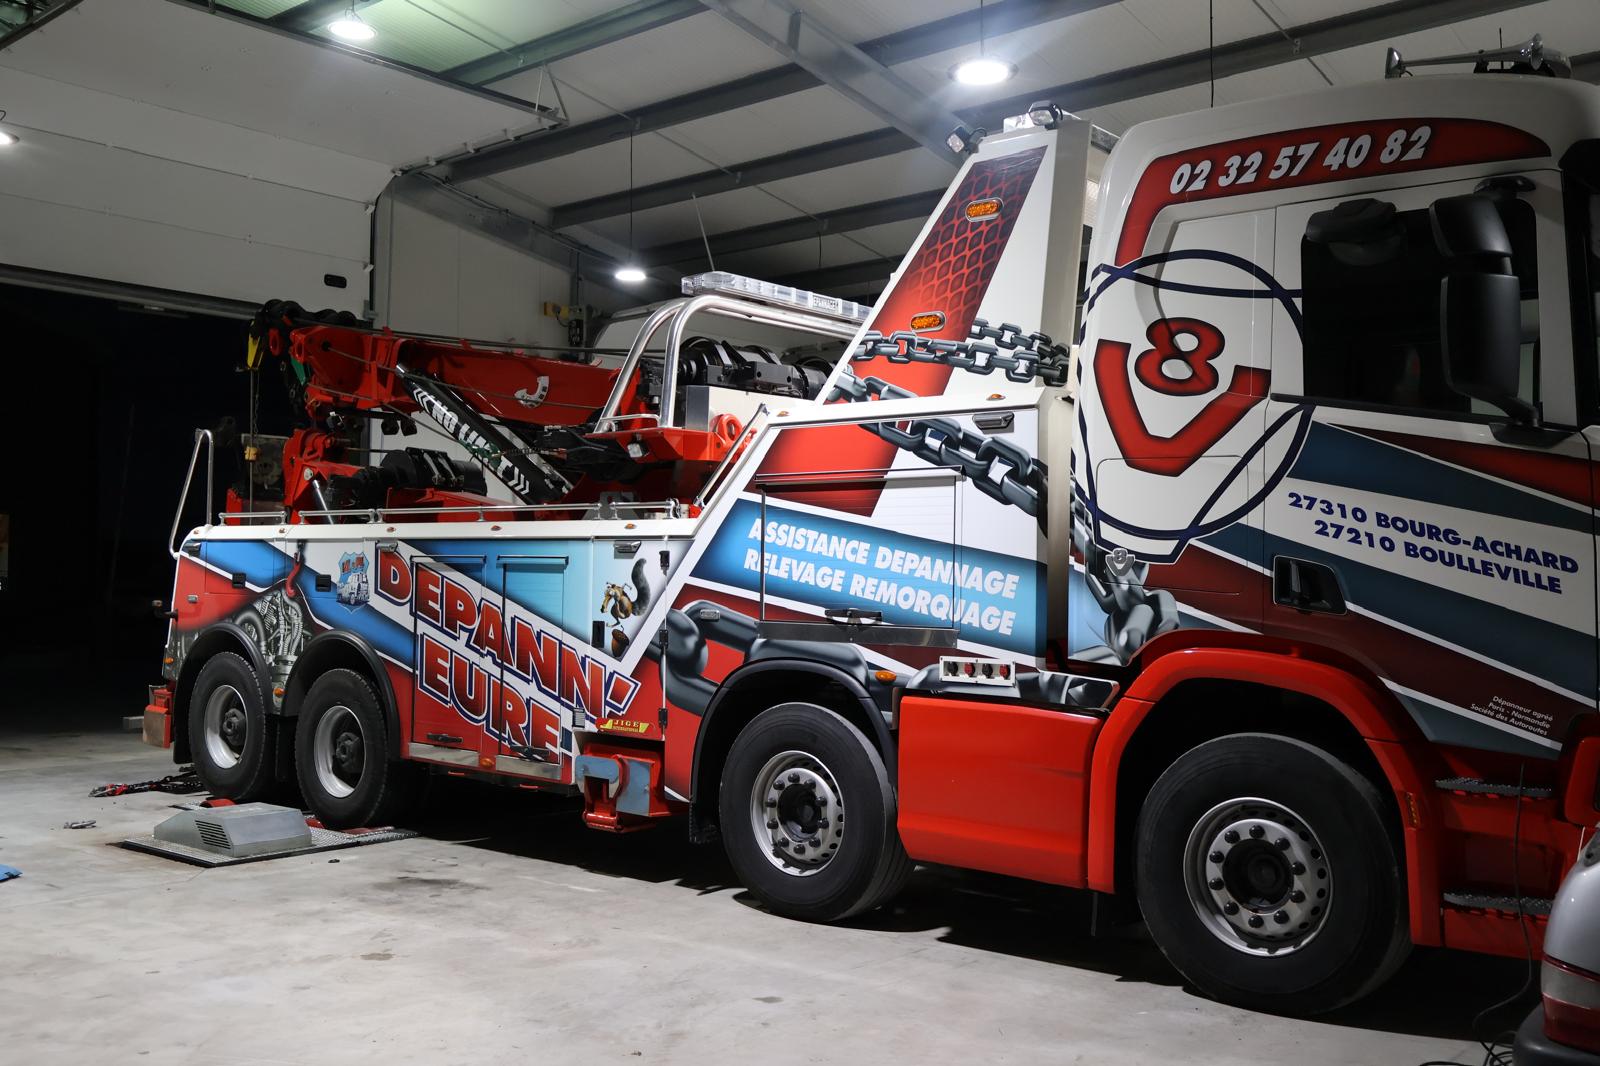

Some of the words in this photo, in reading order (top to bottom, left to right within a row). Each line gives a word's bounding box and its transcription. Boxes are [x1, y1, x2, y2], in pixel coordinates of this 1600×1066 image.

[1169, 160, 1211, 194] 02
[1218, 151, 1263, 188] 32
[1268, 142, 1320, 180] 57
[1323, 134, 1372, 170] 40
[1379, 126, 1432, 164] 82
[458, 423, 513, 478] LIMT
[748, 518, 871, 566] ASSISTANCE
[873, 545, 1020, 600] DEPANNAGE
[1287, 492, 1368, 521] 27310
[1375, 511, 1579, 574] BOURG-ACHARD
[1314, 520, 1395, 552] 27210
[1404, 540, 1563, 594] BOULLEVILLE
[743, 547, 846, 593] RELEVAGE
[849, 574, 1017, 636] REMORQUAGE
[417, 632, 566, 765] EURE
[614, 719, 639, 728] JIGE
[1471, 704, 1494, 716] Société
[1496, 713, 1507, 721] des
[1509, 718, 1547, 735] Autoroutes
[1488, 702, 1505, 712] Paris
[1512, 711, 1550, 728] Normandie
[1493, 696, 1531, 713] Dépanneur
[1532, 711, 1553, 721] agréé
